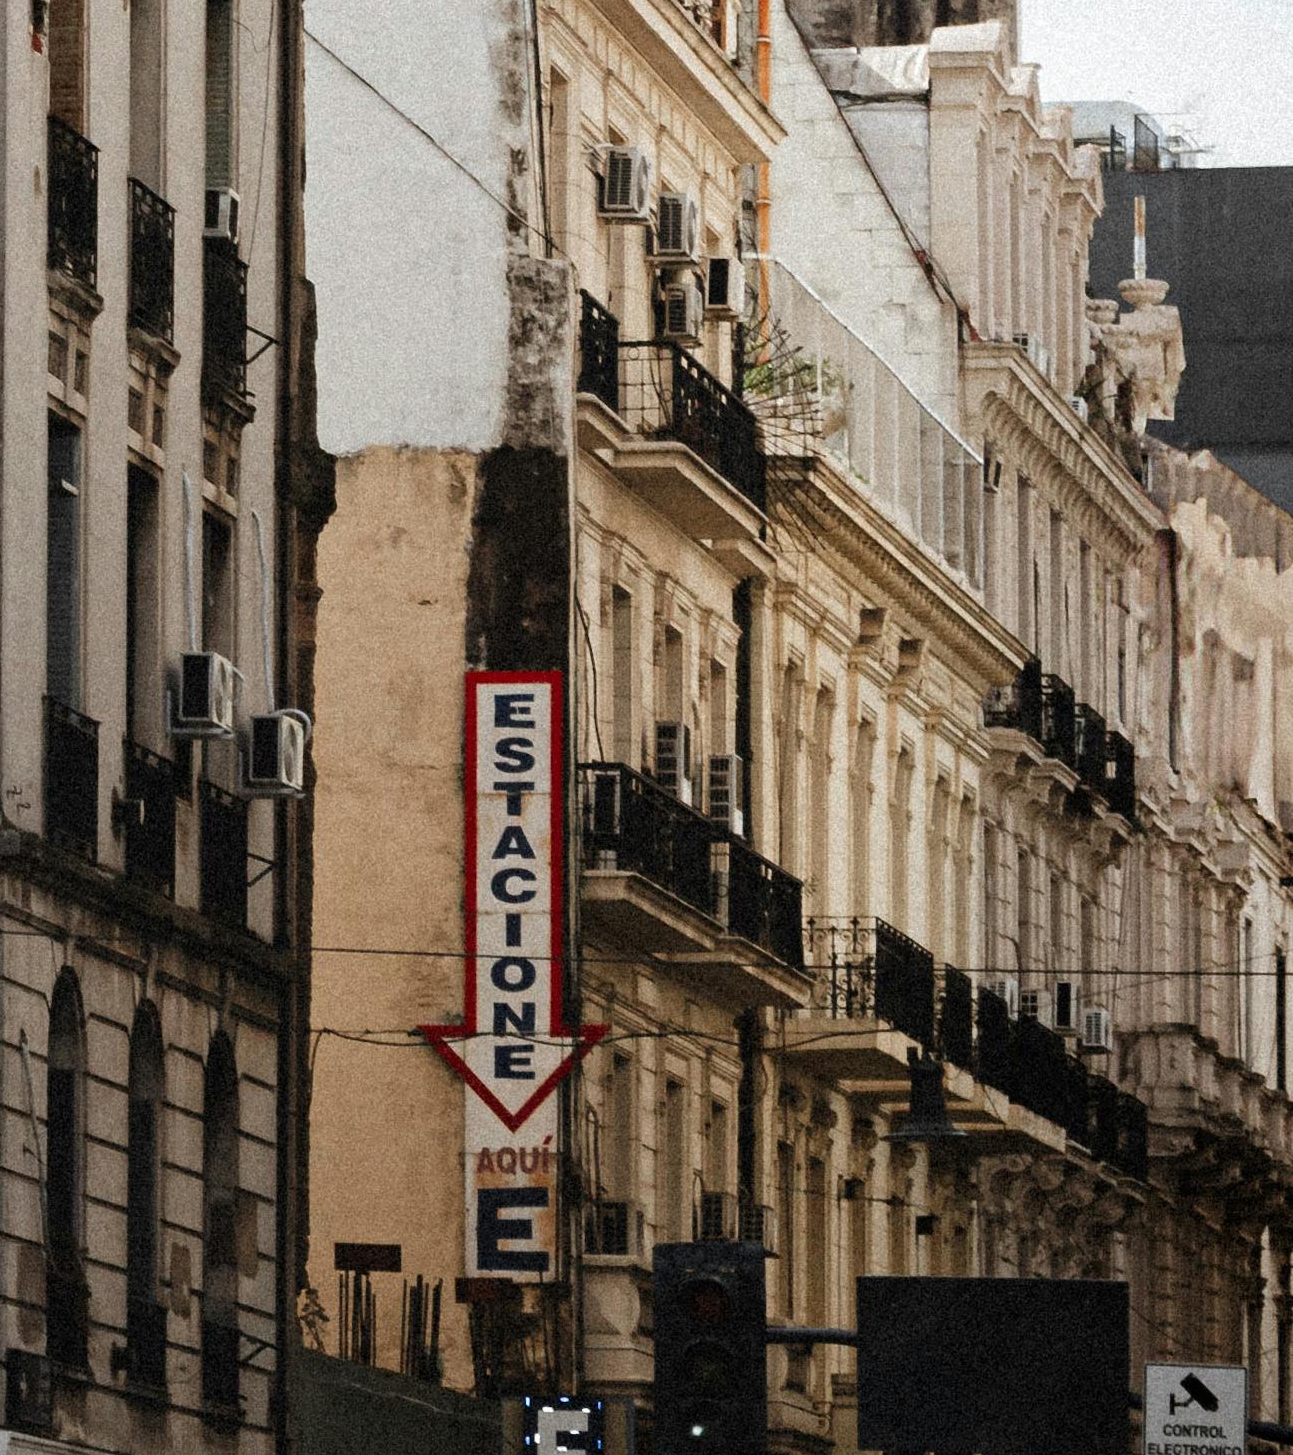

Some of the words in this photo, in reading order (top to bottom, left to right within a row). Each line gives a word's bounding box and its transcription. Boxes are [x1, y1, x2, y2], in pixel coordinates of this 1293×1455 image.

[490, 693, 537, 1081] ESTACIONE
[477, 1134, 553, 1175] AQUÍ
[476, 1187, 550, 1272] E
[1163, 1423, 1227, 1440] CONTROL
